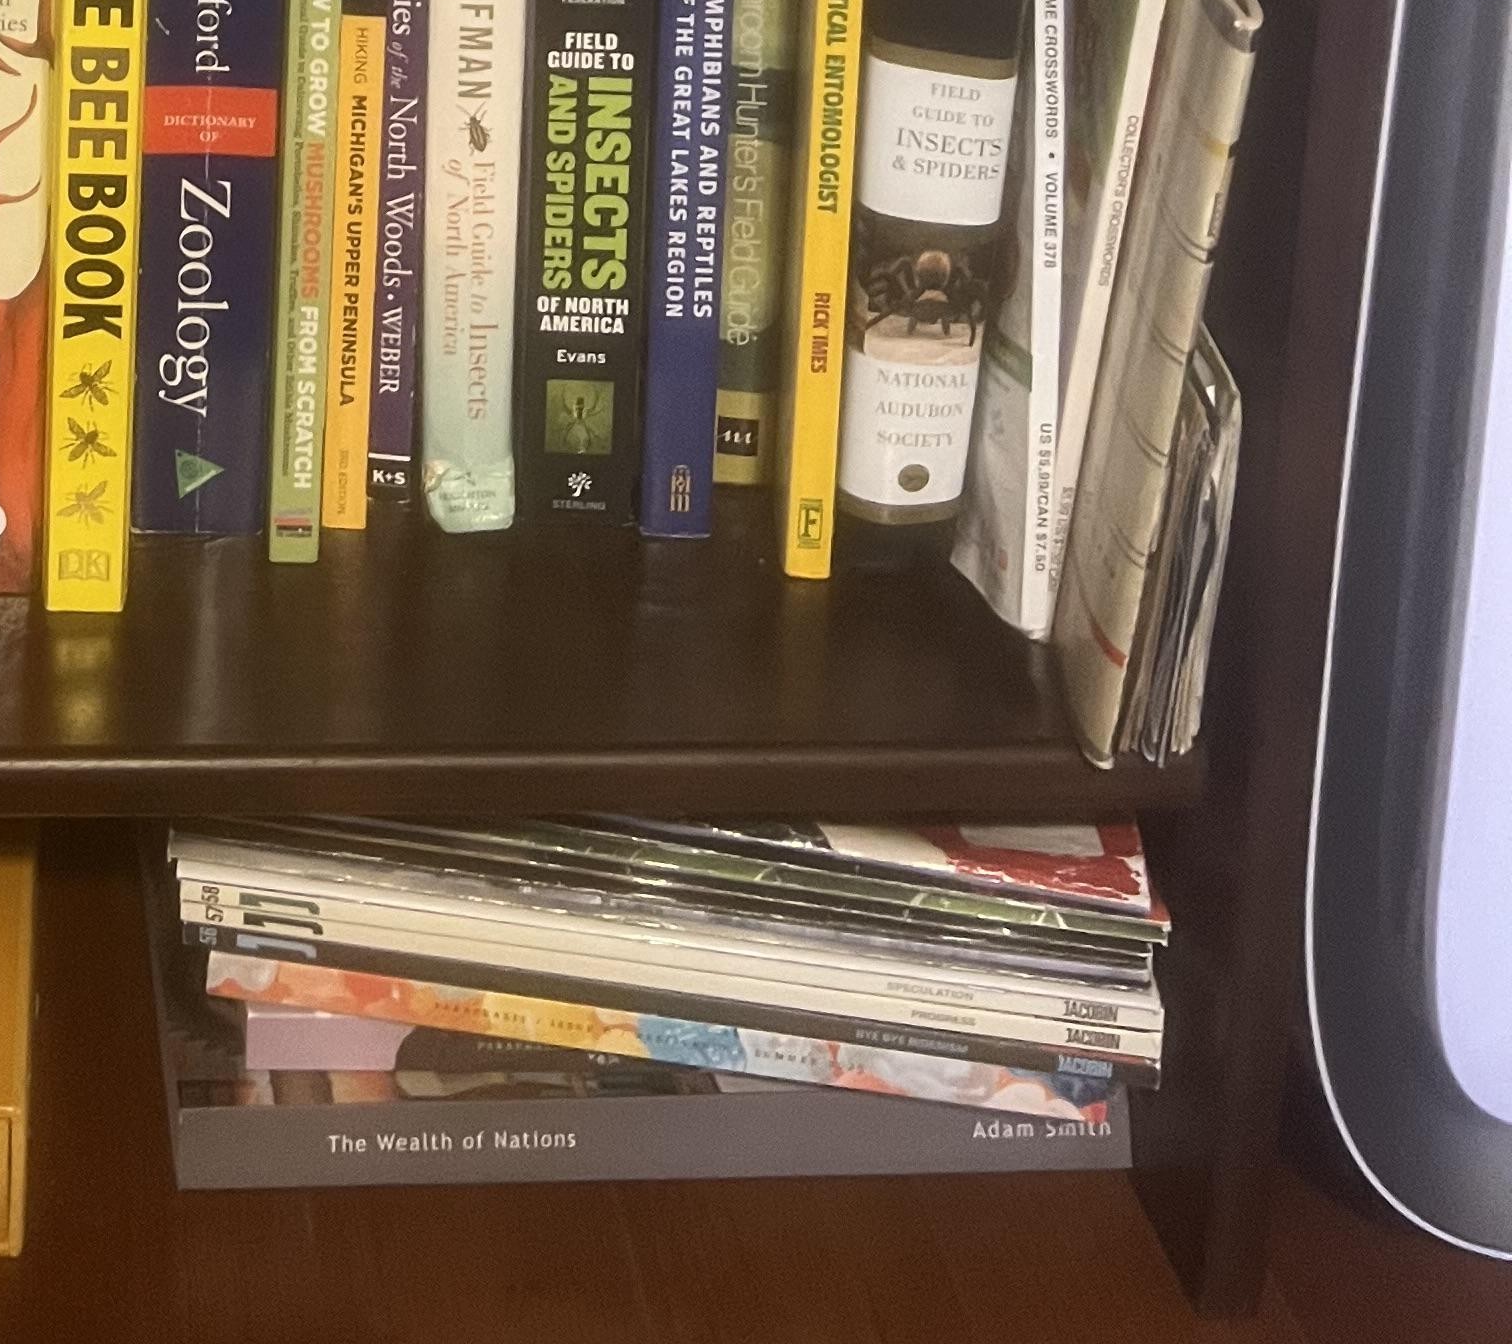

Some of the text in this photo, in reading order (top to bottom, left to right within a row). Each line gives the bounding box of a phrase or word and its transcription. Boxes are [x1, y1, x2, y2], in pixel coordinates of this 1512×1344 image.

[565, 31, 618, 51] FIELD
[547, 51, 634, 70] GUIDE TO
[1044, 23, 1059, 139] CROSSWORDS
[67, 45, 131, 161] BEE
[163, 113, 257, 129] DICTIONARY
[542, 74, 578, 290] AND SPIDERS
[581, 75, 633, 291] INSECTS
[1043, 171, 1059, 269] VOLUME 378
[62, 172, 128, 340] BOOK
[158, 178, 233, 418] Zoology
[556, 348, 607, 364] Evans
[201, 885, 220, 904] 58
[204, 903, 225, 923] 57
[327, 1129, 577, 1153] The Wealth of Nations
[972, 1119, 1035, 1141] Adam
